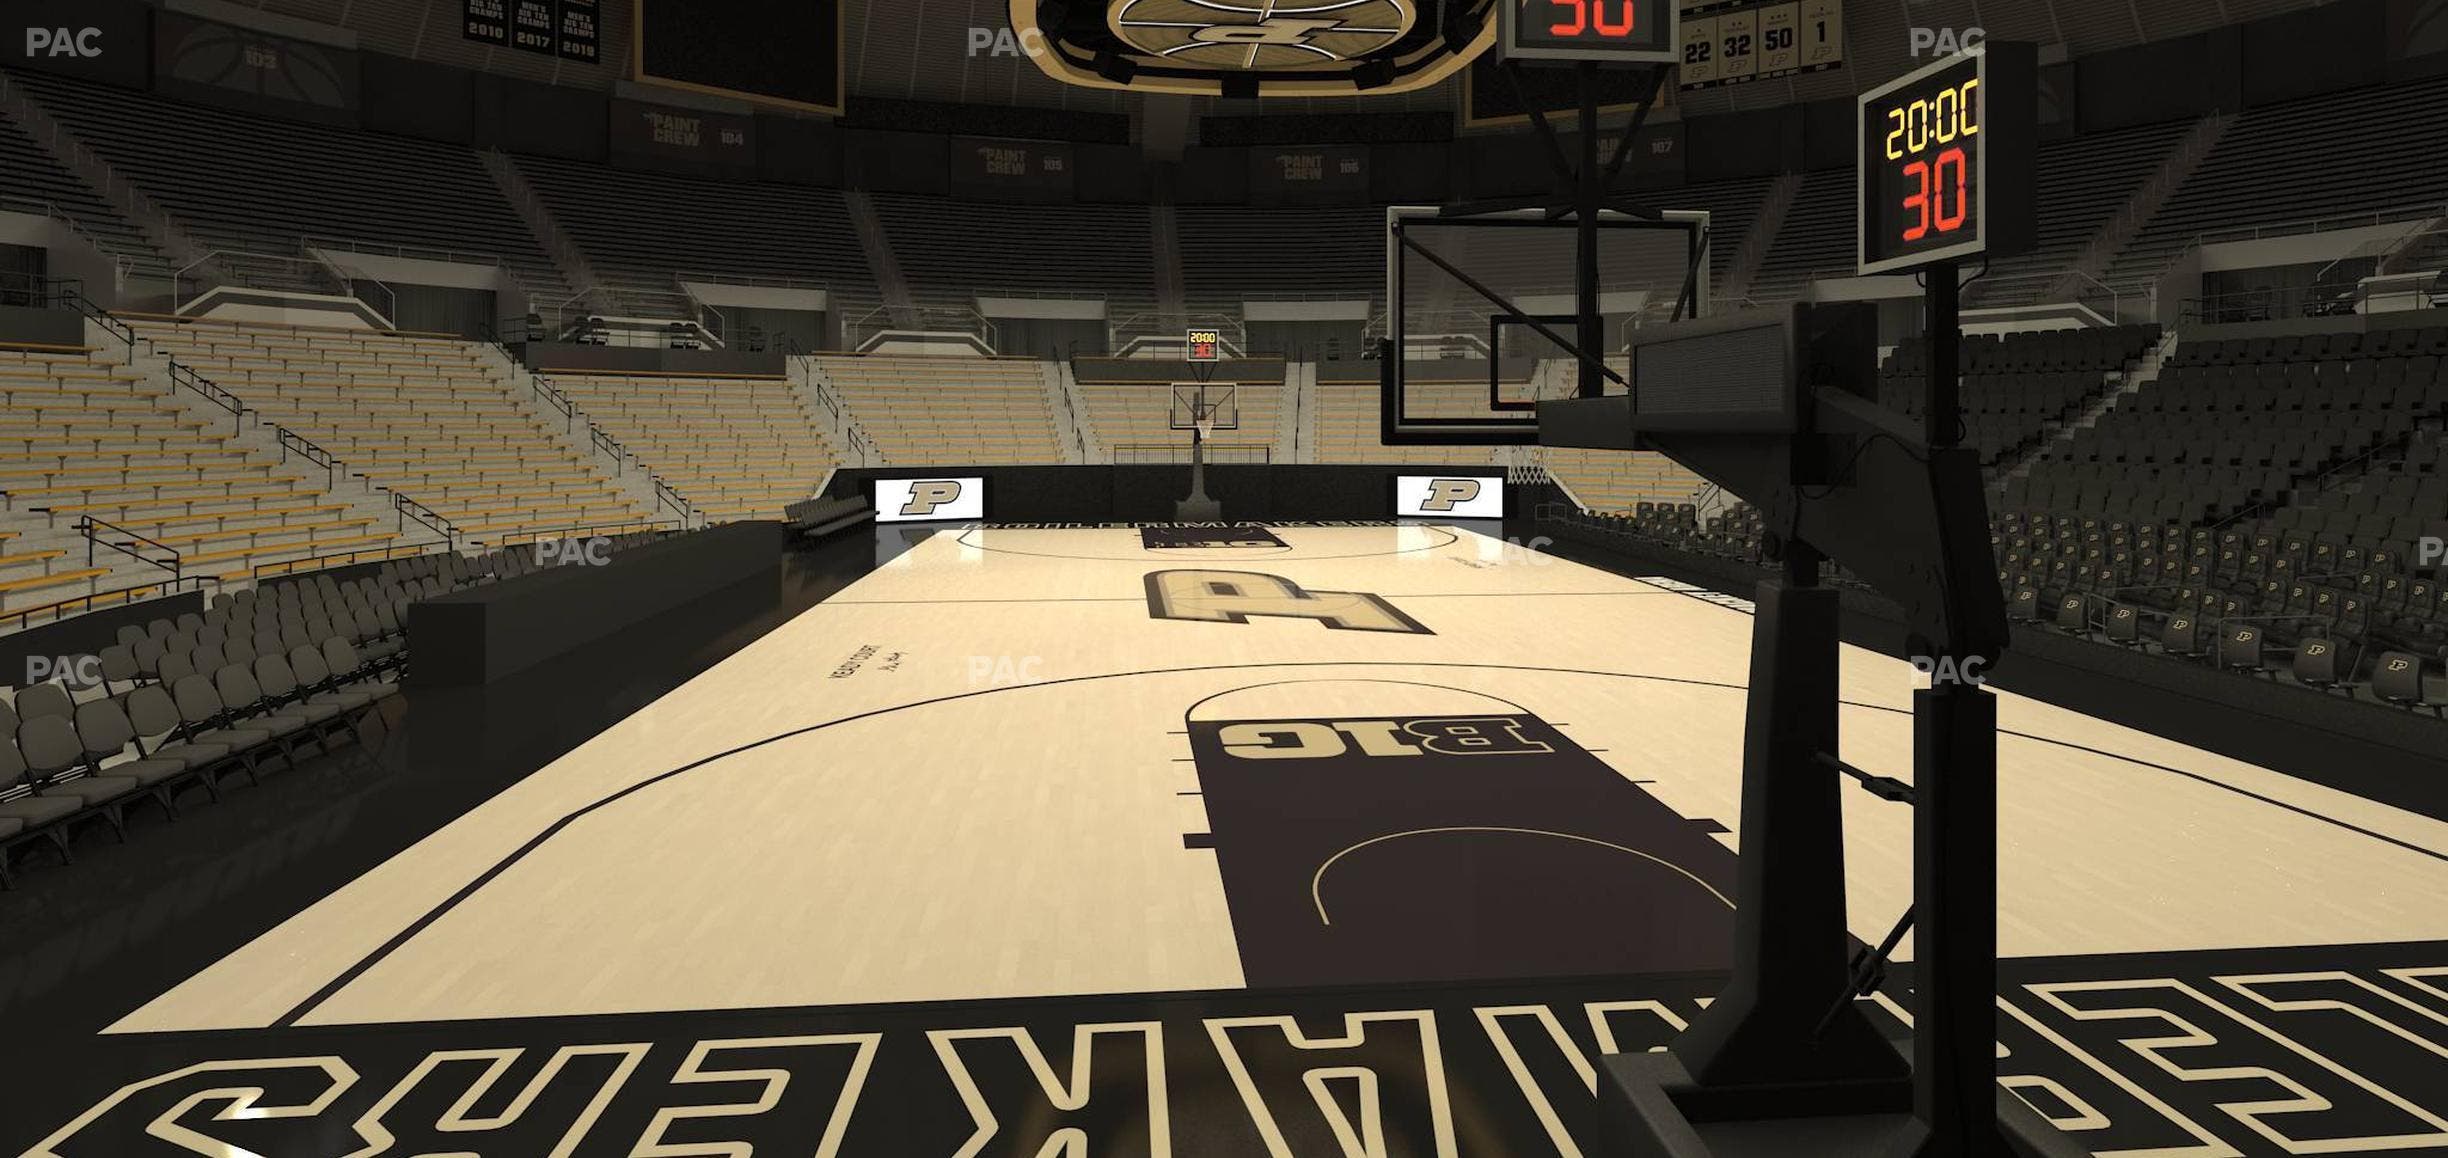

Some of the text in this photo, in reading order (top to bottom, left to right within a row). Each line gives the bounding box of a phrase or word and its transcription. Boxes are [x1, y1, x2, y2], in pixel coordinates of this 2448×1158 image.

[468, 22, 504, 38] 2010
[1816, 21, 1825, 42] 1
[517, 31, 551, 48] 2017
[1724, 35, 1751, 58] 32
[1765, 27, 1793, 51] 50
[1685, 41, 1711, 64] 22
[653, 112, 700, 132] PAINT
[653, 129, 700, 146] CREW
[721, 129, 744, 145] 104
[986, 148, 1027, 161] PAINT
[1283, 155, 1323, 168] PAINT
[986, 161, 1026, 175] CREW
[1284, 167, 1323, 180] CREW
[1903, 147, 1966, 241] 30
[1190, 332, 1216, 343] 20:00
[900, 481, 961, 515] P
[1420, 479, 1480, 511] P
[1143, 568, 1438, 636] P
[2116, 608, 2131, 619] P
[2172, 619, 2189, 630] P
[2235, 631, 2253, 642] P
[2306, 644, 2326, 656] P
[2387, 659, 2409, 672] P
